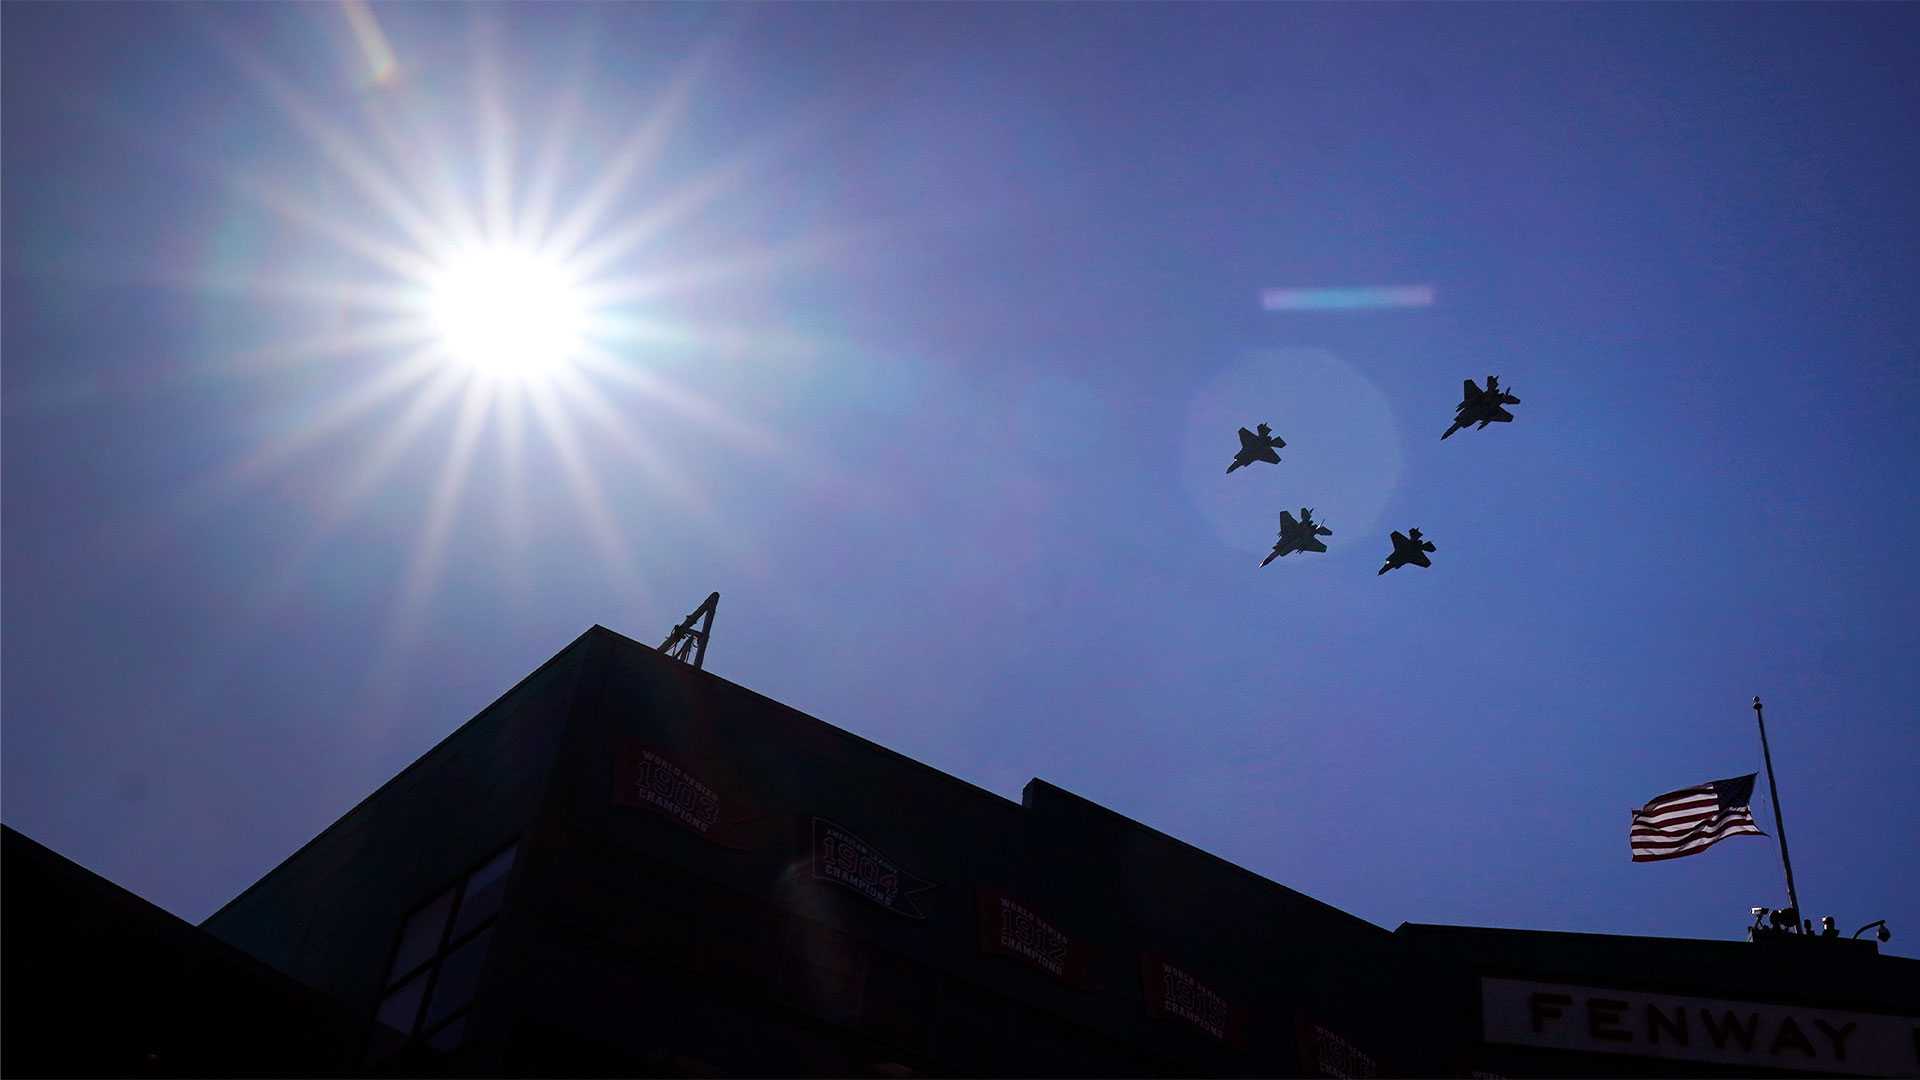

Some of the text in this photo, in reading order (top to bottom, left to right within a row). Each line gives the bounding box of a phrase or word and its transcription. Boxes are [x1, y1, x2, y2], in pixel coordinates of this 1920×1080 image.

[641, 750, 681, 776] WORLD
[634, 760, 721, 824] 1903
[639, 788, 711, 832] CHAMPIONS
[824, 837, 898, 899] 1904
[824, 864, 893, 906] CHAMPIONS
[1000, 896, 1034, 921] WORLD
[1000, 935, 1064, 977] CHAMPIONS
[1163, 999, 1224, 1040] CHAMPIONS
[1531, 991, 1855, 1062] FENWAY
